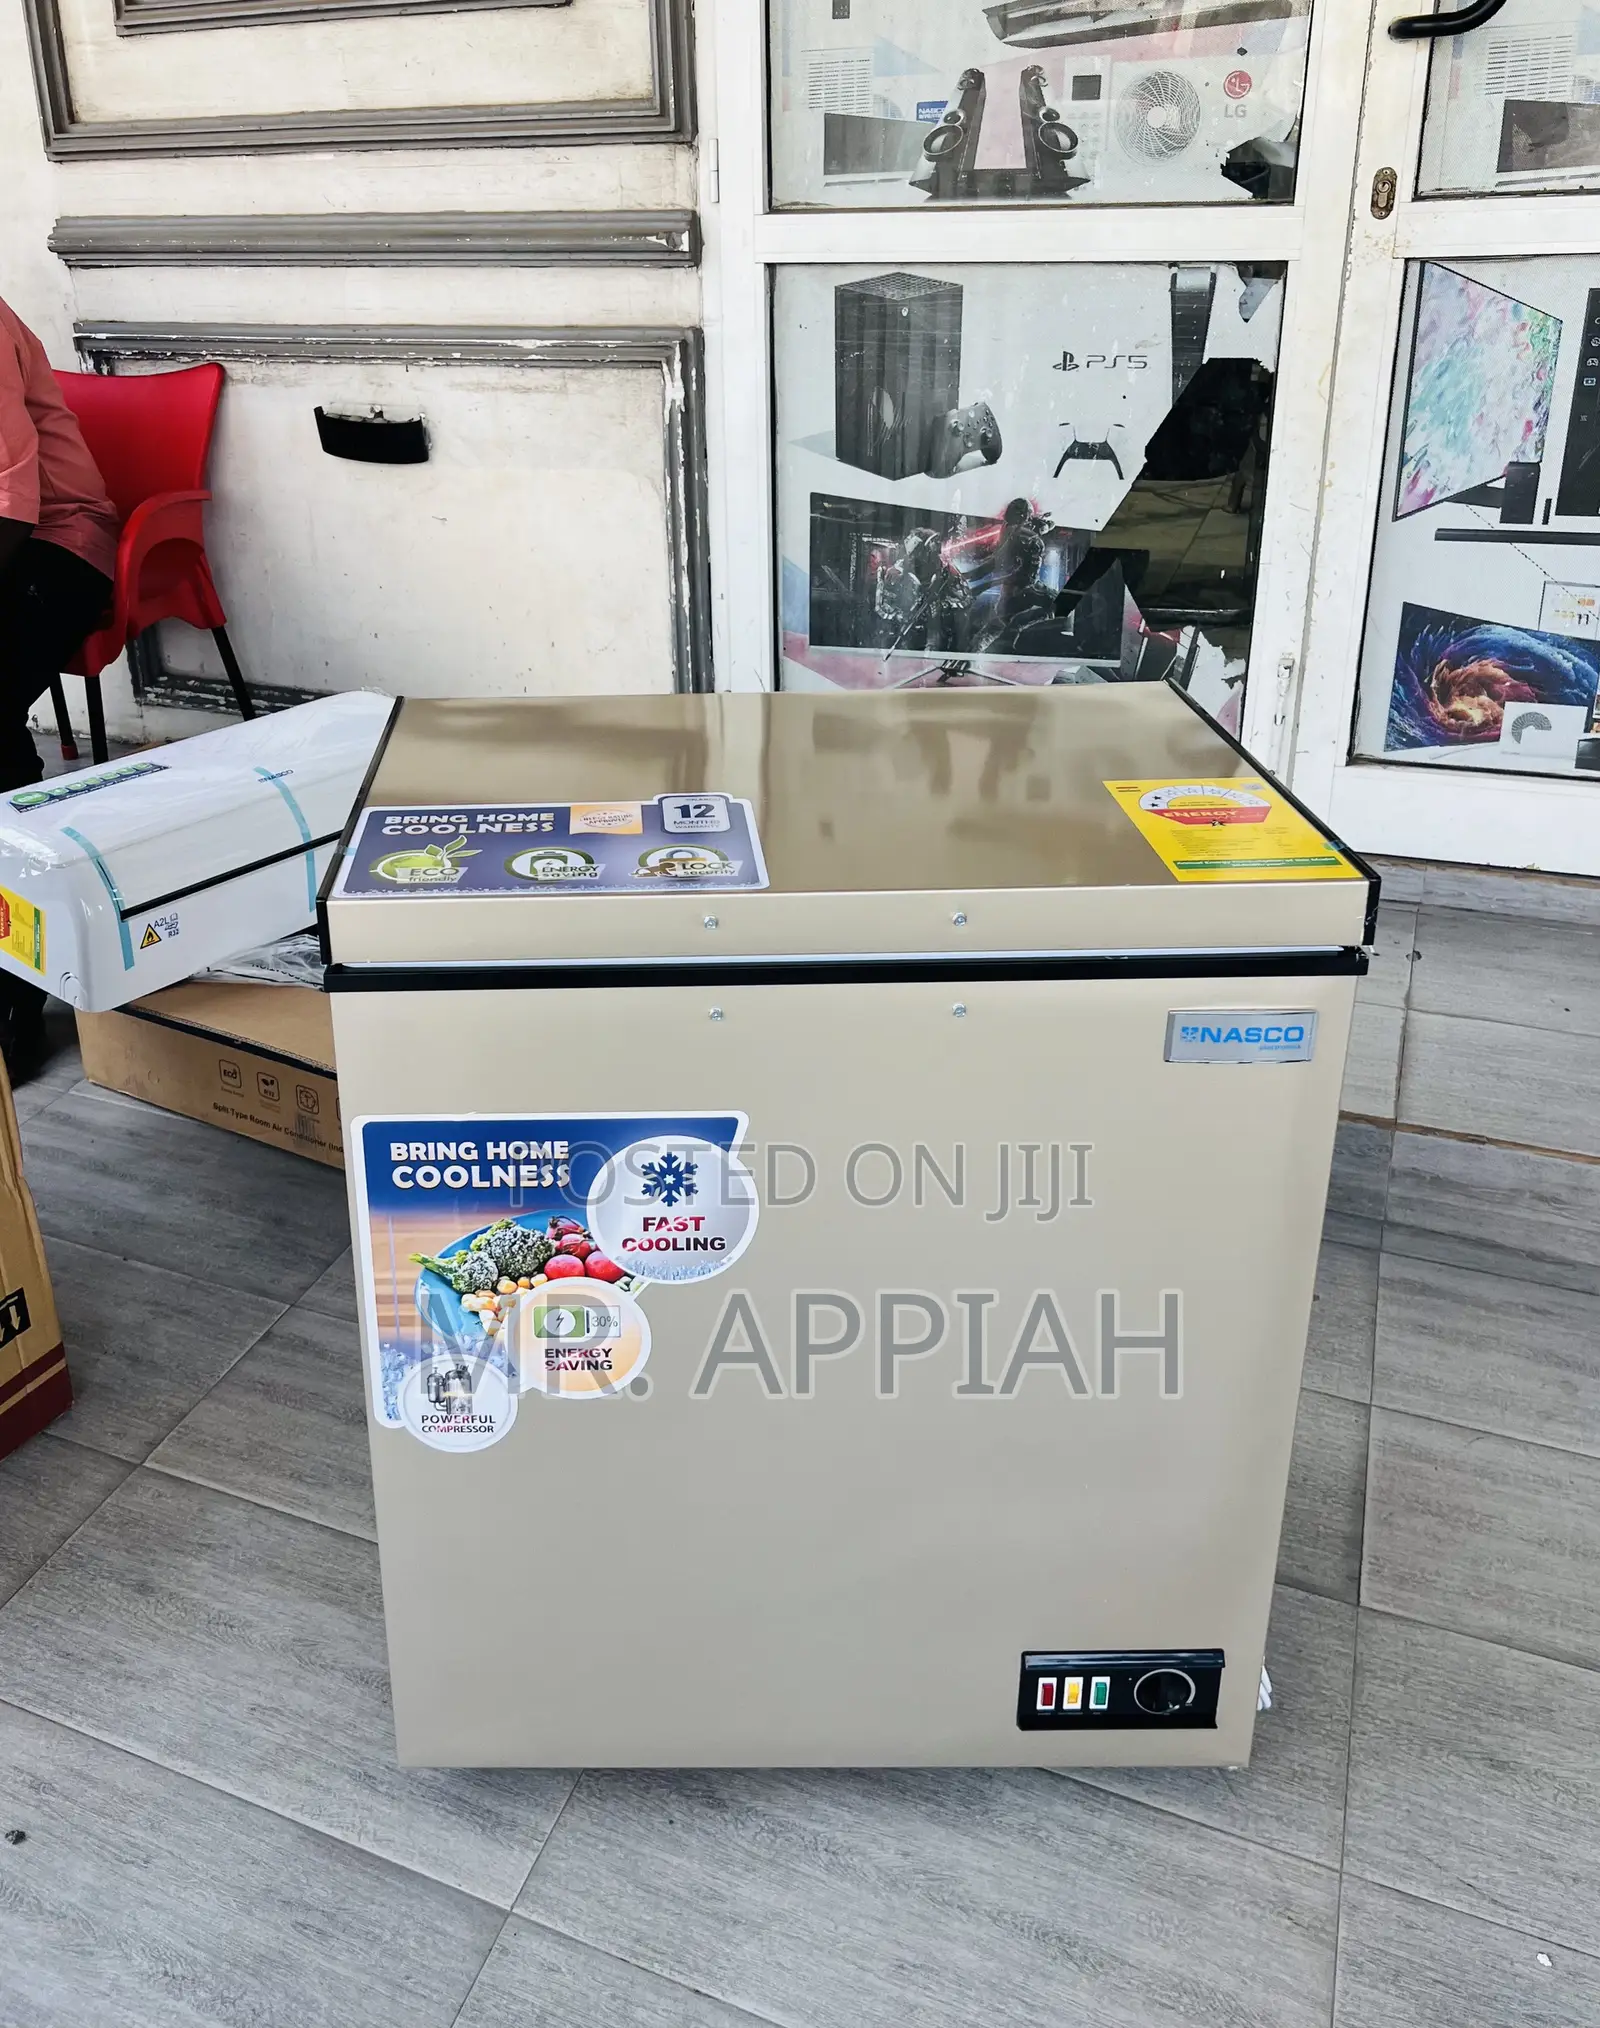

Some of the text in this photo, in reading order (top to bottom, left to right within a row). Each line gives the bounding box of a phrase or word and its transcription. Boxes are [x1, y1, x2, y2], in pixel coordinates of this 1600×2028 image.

[1223, 104, 1247, 118] LG
[1086, 354, 1148, 369] PS5
[673, 803, 716, 819] 12
[1162, 810, 1238, 818] ENERGY
[384, 812, 555, 825] BRING HOME
[381, 822, 554, 835] COOLNESS
[409, 868, 461, 876] ECO
[542, 865, 600, 873] ENERGY
[681, 861, 735, 870] LOCK
[153, 916, 170, 928] A2L
[1200, 1026, 1304, 1044] NASCO
[212, 1102, 229, 1114] Split
[230, 1107, 248, 1120] Type
[249, 1114, 271, 1128] Room
[272, 1123, 282, 1133] Air
[389, 1140, 569, 1161] BRING HOME
[391, 1163, 571, 1189] COOLNESS
[642, 1215, 706, 1232] FAST
[621, 1236, 727, 1252] COOLING
[591, 1315, 619, 1329] 30%
[544, 1347, 613, 1359] ENERGY
[544, 1360, 613, 1372] SAVING
[421, 1414, 497, 1424] POWERFUL
[421, 1425, 495, 1434] COMPRESSOR
